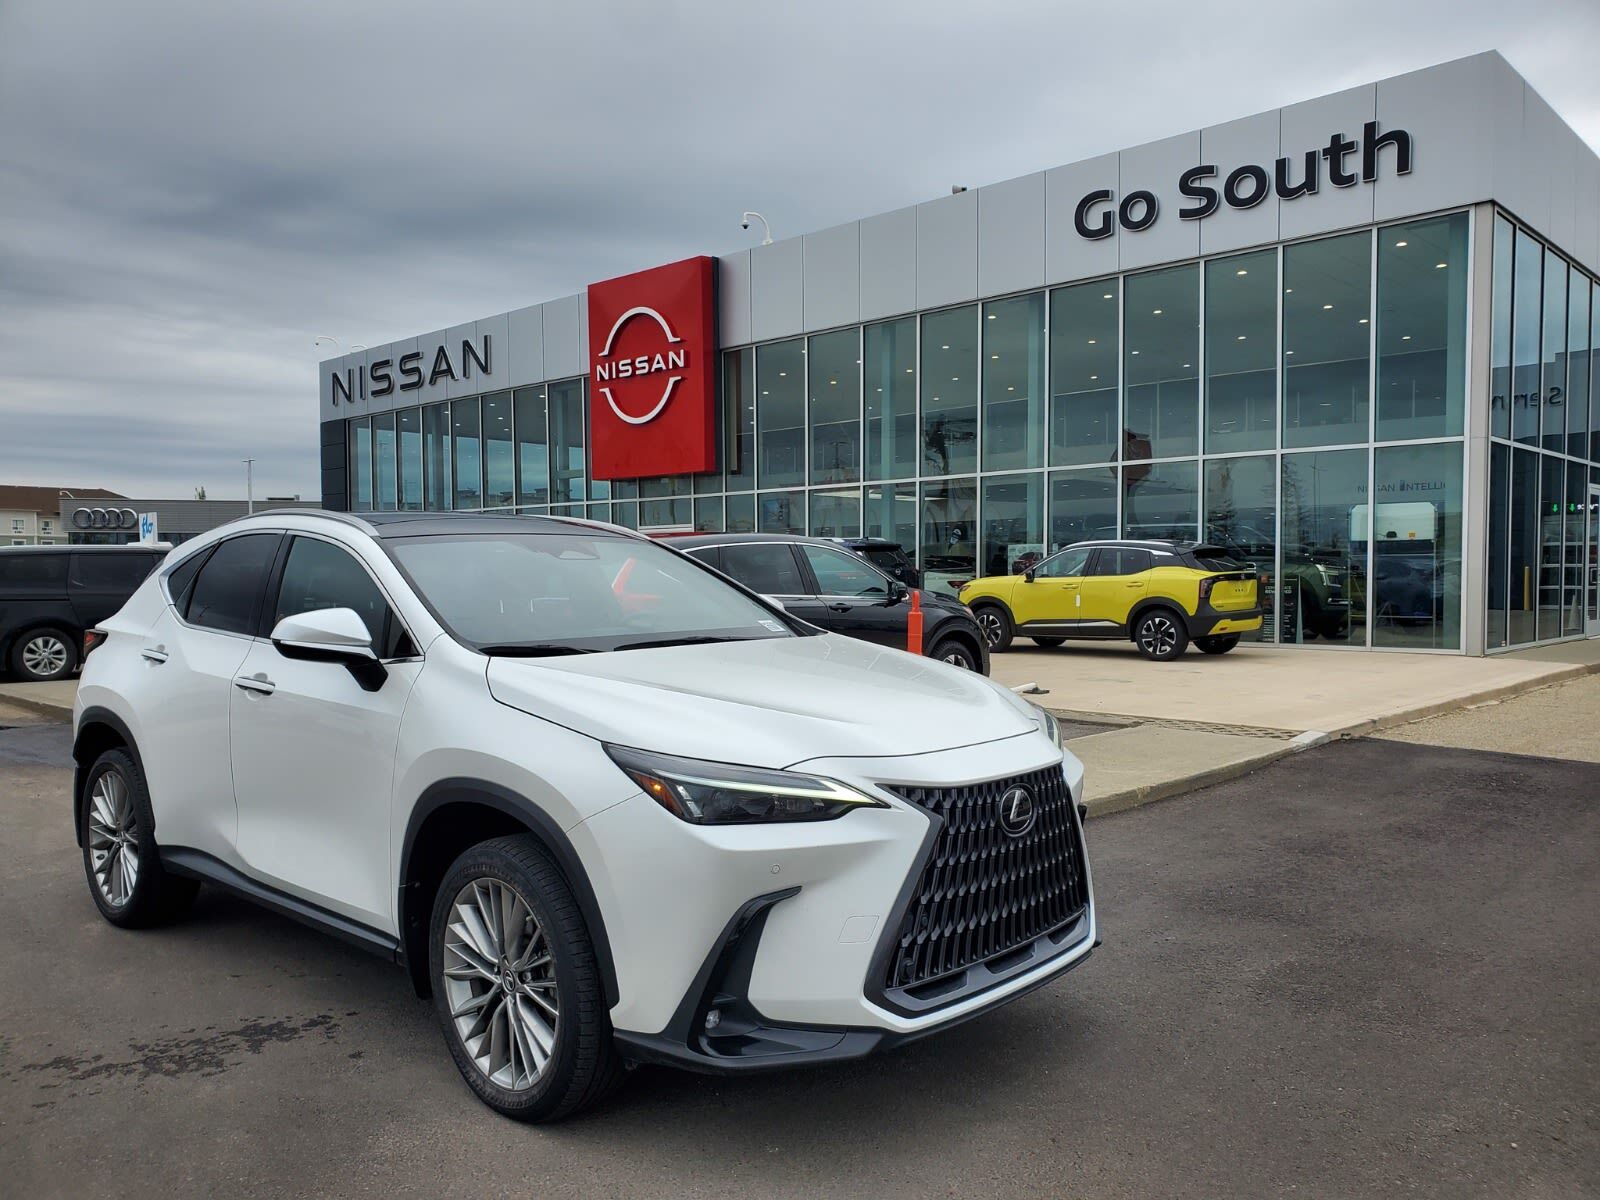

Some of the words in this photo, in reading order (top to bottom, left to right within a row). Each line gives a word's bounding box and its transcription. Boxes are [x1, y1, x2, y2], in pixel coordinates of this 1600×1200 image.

[1074, 189, 1159, 240] Go
[1178, 120, 1413, 220] South
[332, 334, 492, 406] NISSAN
[596, 349, 685, 382] NISSAN
